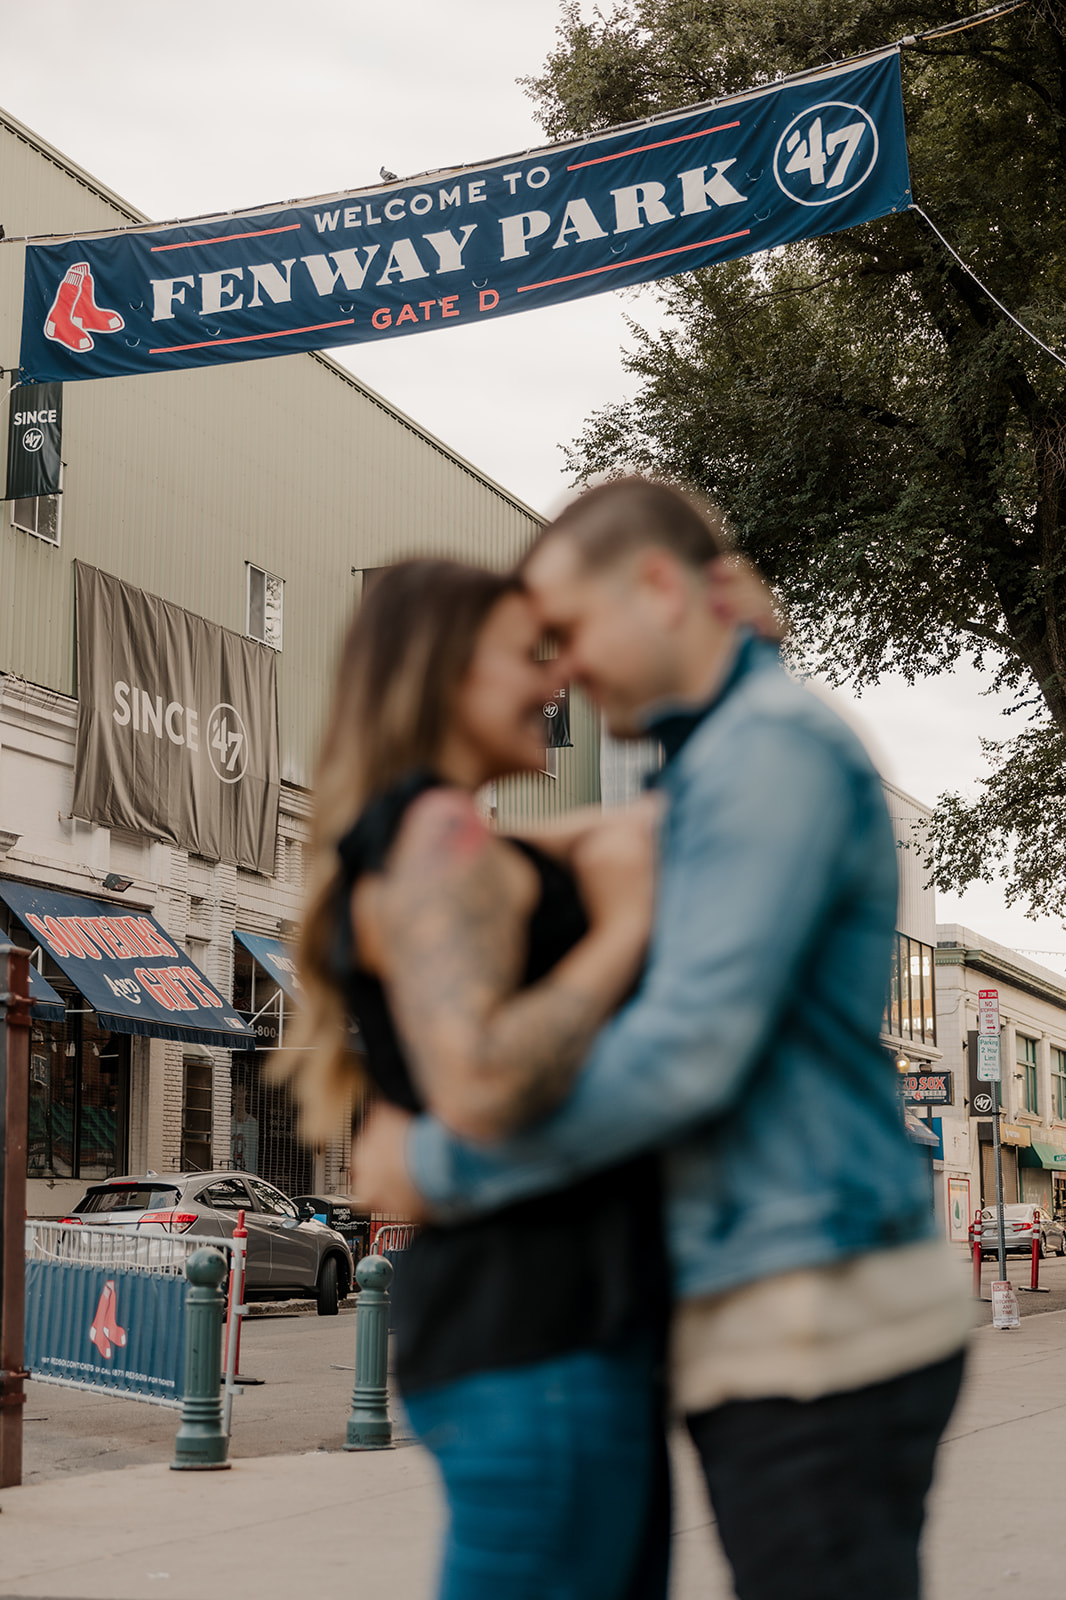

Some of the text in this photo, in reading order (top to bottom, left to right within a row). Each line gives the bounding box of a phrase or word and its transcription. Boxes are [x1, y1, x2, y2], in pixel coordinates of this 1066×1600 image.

[314, 166, 550, 233] WELCOME TO
[150, 158, 748, 322] FENWAY PARK
[371, 289, 500, 330] GATE D
[13, 410, 57, 426] SINCE
[113, 680, 199, 752] SINCE
[25, 912, 179, 961] SOUVENIRS
[134, 966, 223, 1012] GIFTS
[980, 1039, 999, 1047] Parking
[918, 1076, 946, 1090] SOX
